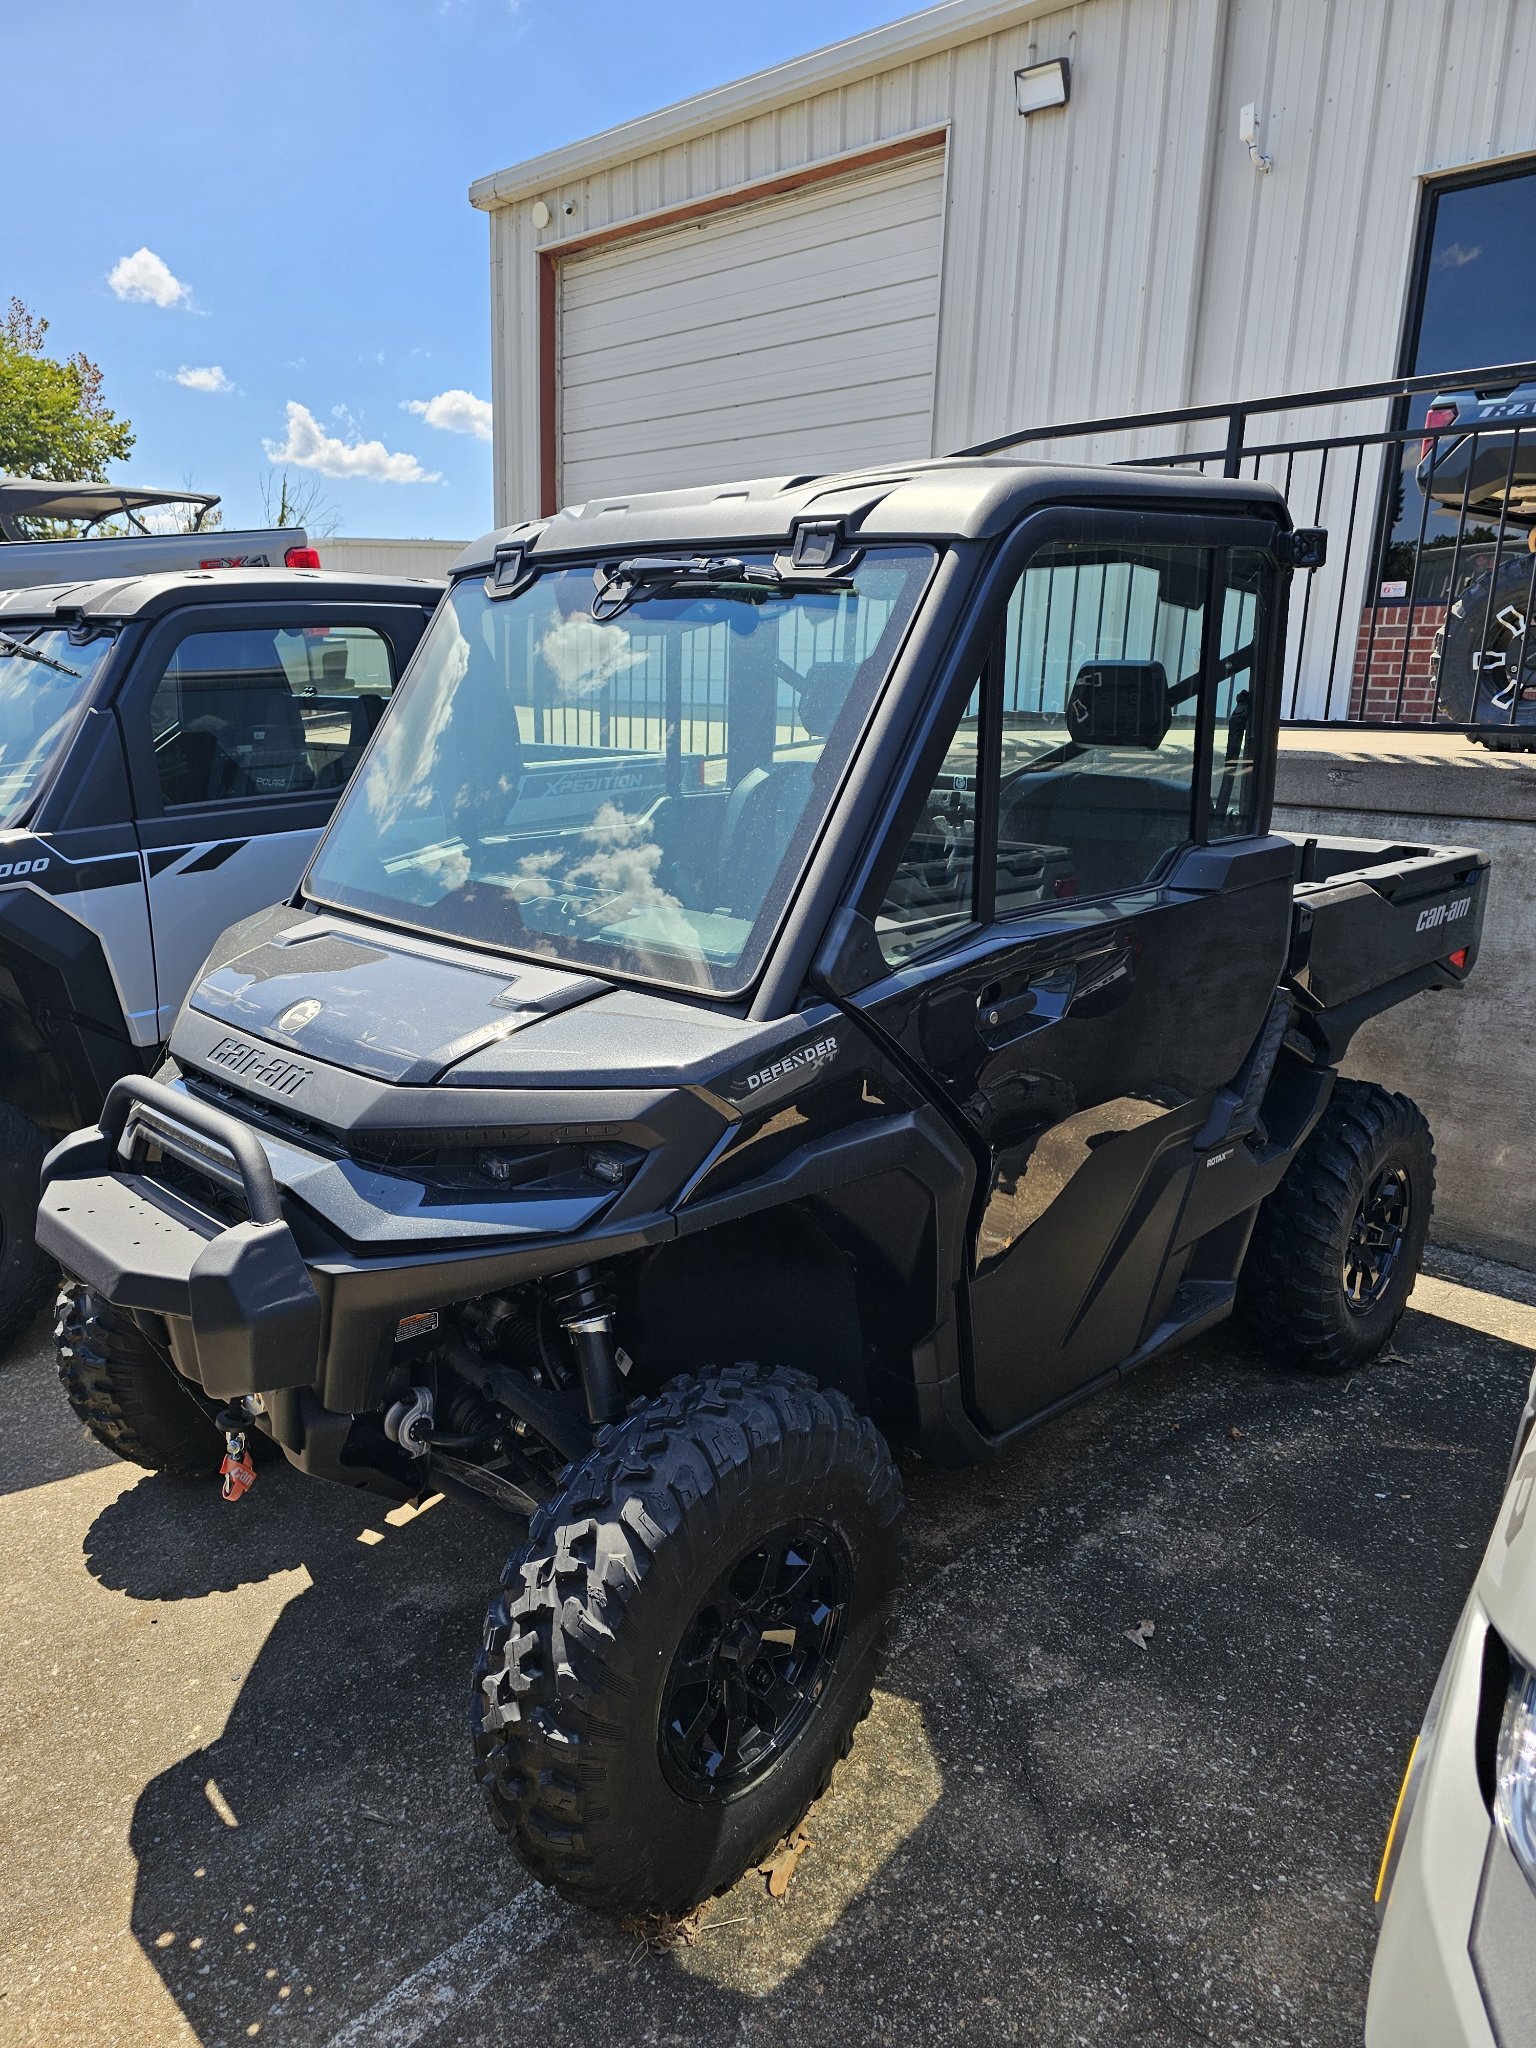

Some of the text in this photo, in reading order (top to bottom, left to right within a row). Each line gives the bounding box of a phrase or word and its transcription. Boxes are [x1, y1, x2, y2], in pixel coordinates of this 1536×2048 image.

[1478, 402, 1536, 418] RA
[543, 773, 643, 797] XPEDITION
[746, 1036, 838, 1090] DEFENDER
[811, 1049, 838, 1071] XT
[1206, 1152, 1226, 1168] ROTAX
